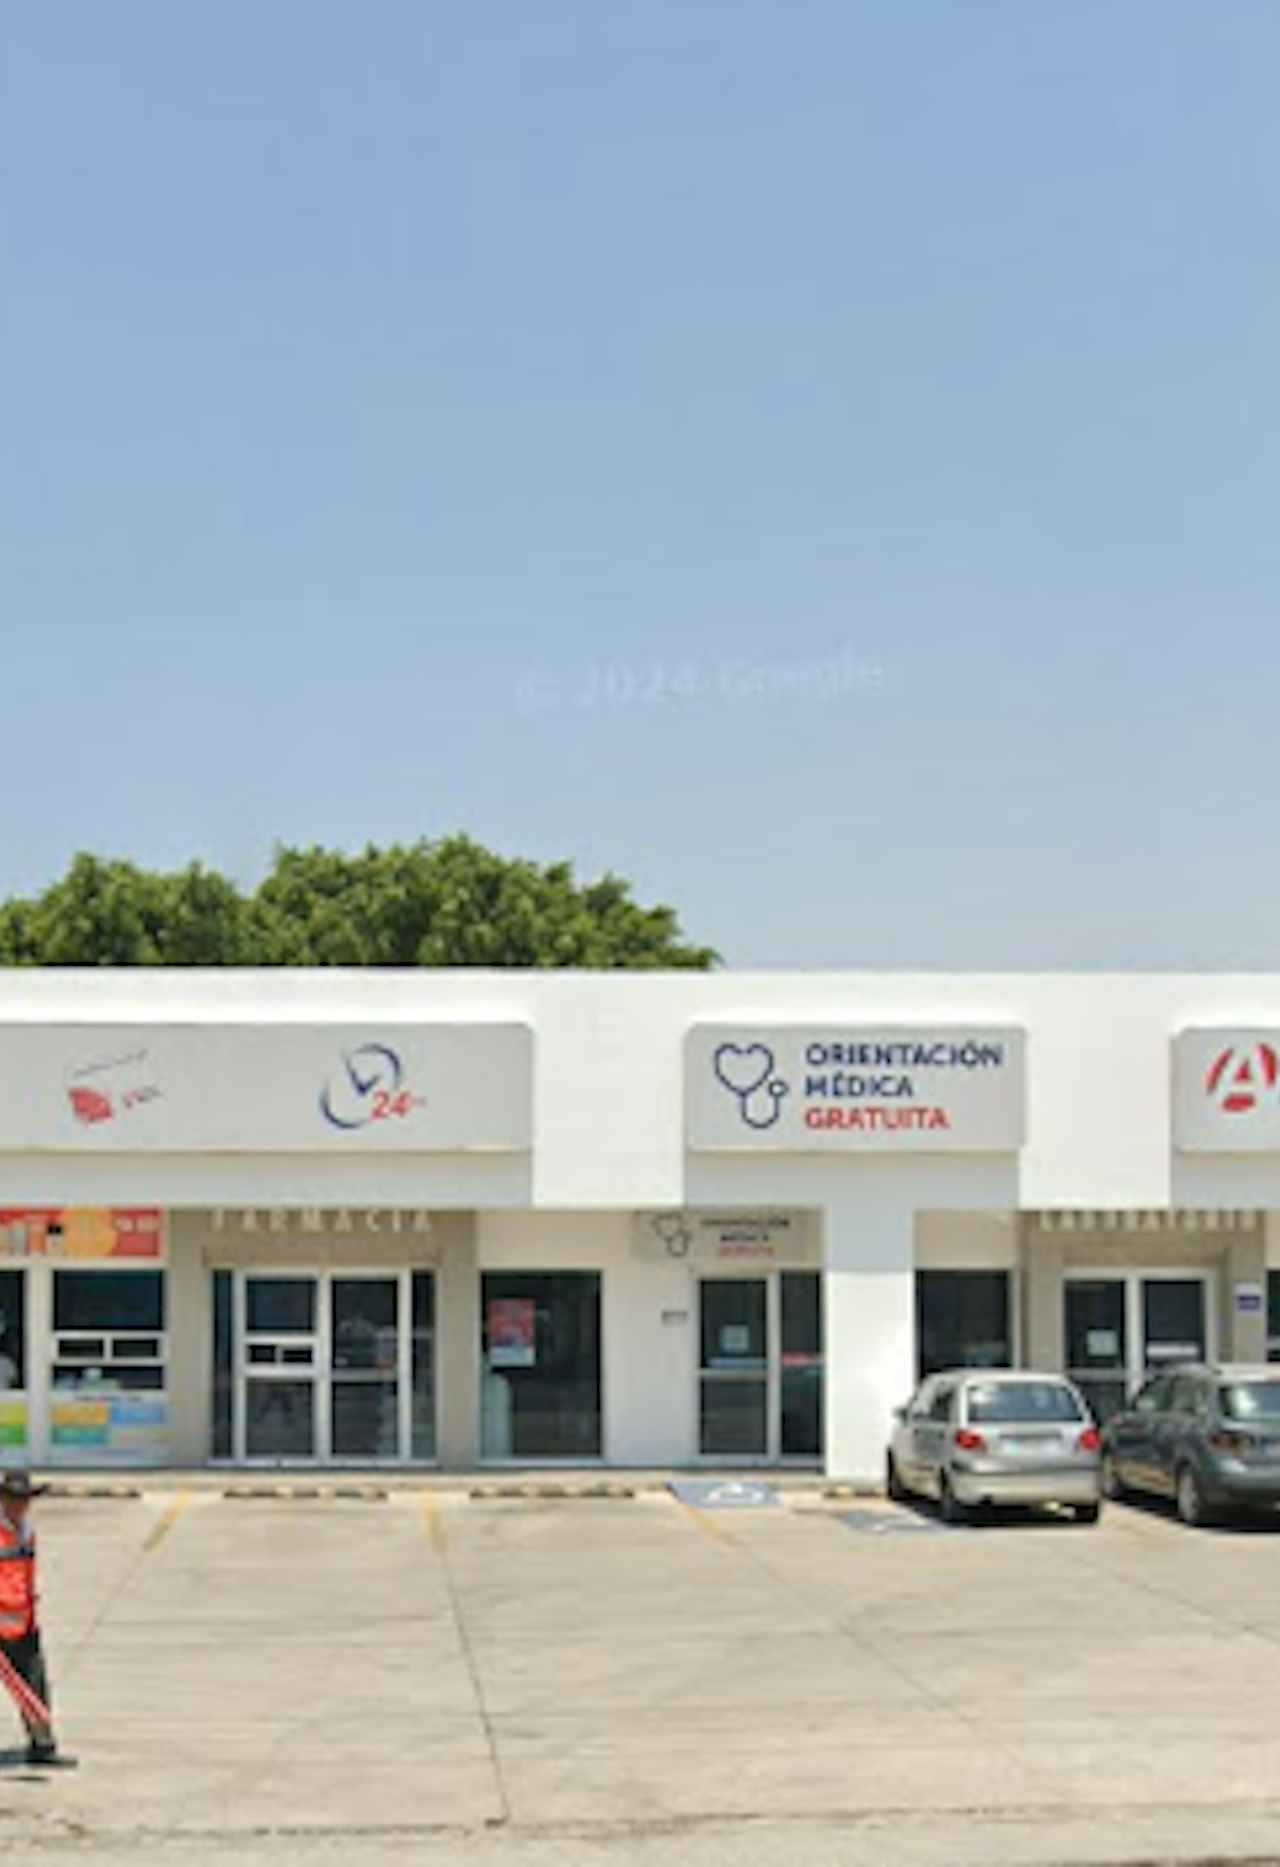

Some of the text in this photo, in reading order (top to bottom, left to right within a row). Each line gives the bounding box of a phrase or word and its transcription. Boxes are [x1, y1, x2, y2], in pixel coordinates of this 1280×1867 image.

[805, 1040, 1004, 1068] ORIENTACIÓN
[805, 1073, 914, 1098] MÉDICA
[805, 1106, 951, 1131] GRATUITA
[212, 1208, 432, 1233] FARMACIA
